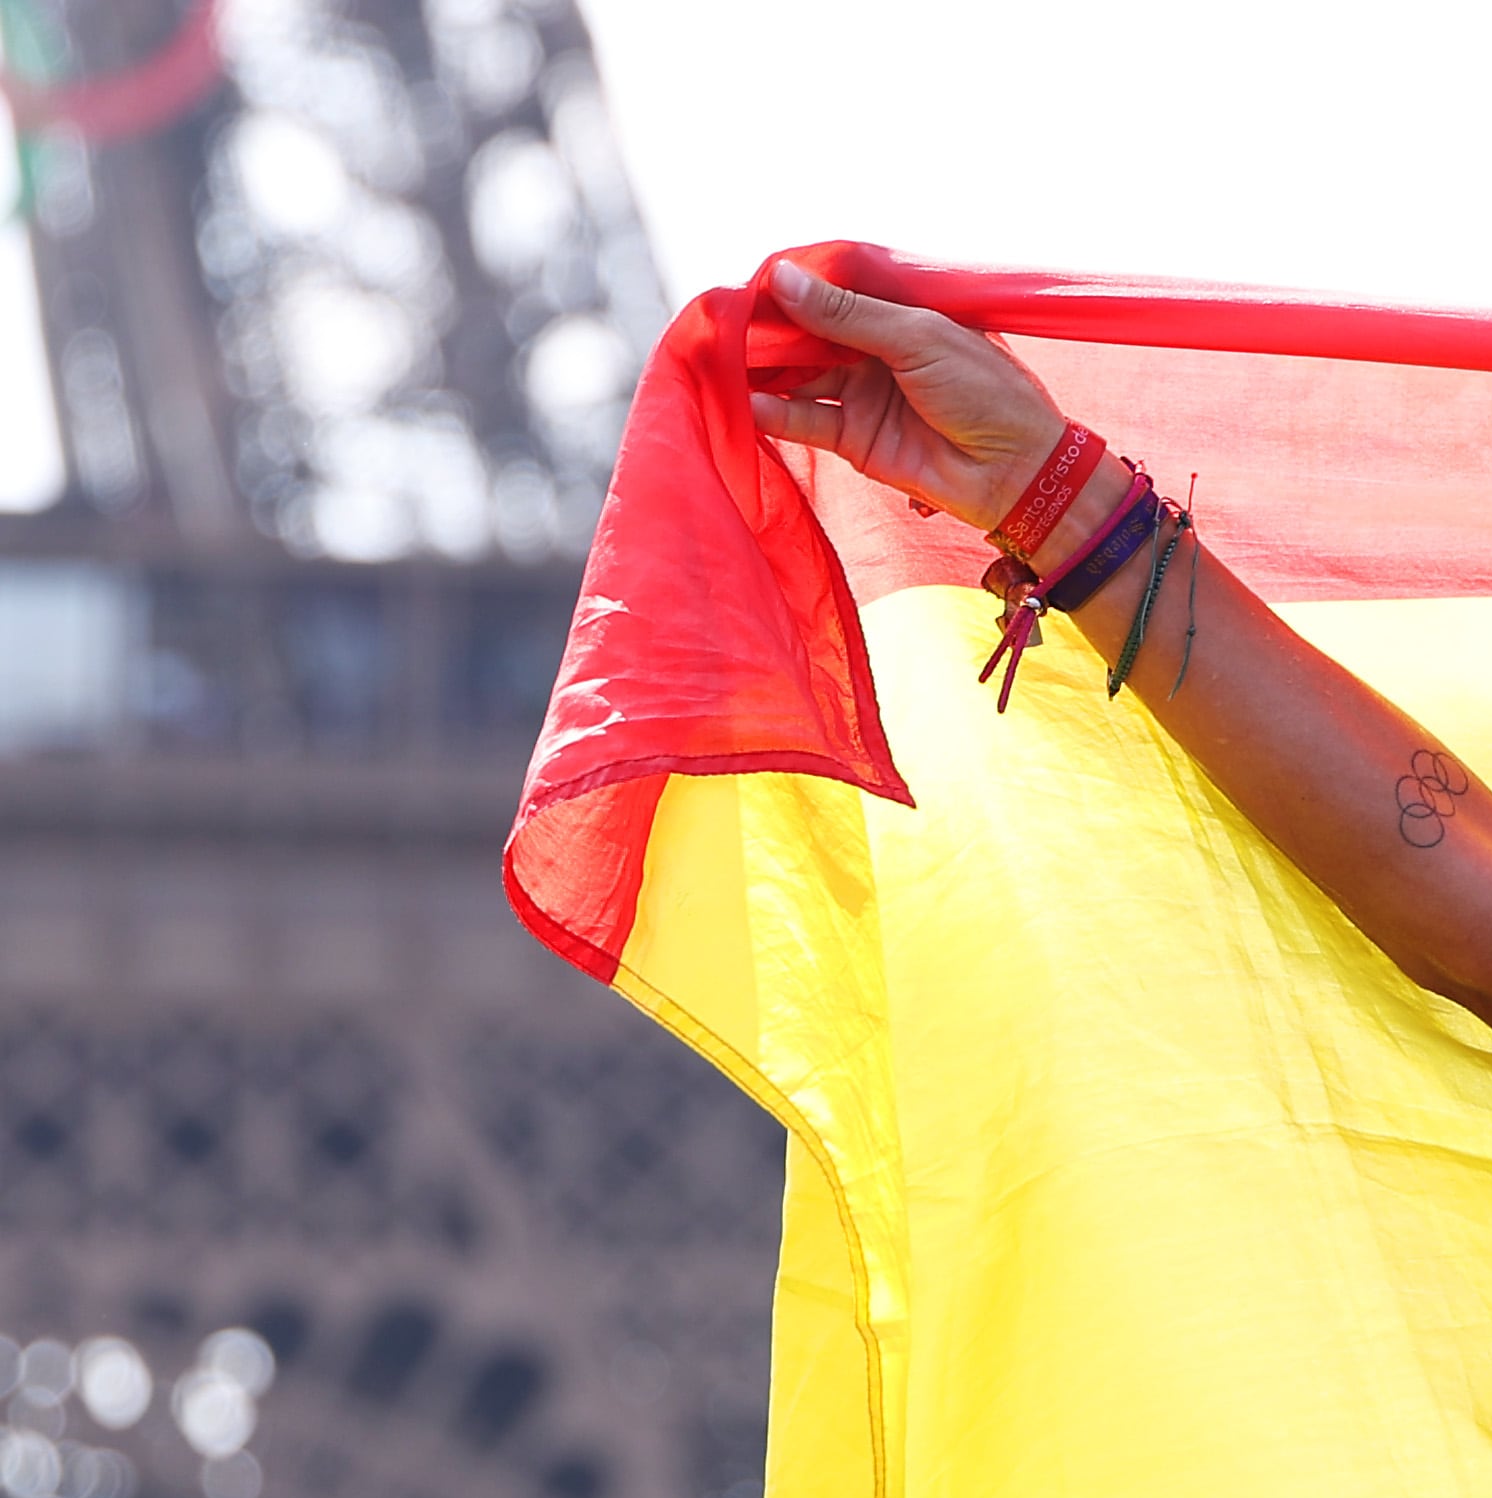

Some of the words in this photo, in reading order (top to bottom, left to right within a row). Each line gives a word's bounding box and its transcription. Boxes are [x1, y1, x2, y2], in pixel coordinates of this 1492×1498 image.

[1006, 493, 1046, 541] Santo
[1038, 444, 1081, 494] Cristo
[1023, 485, 1073, 550] PROTÉGENOS
